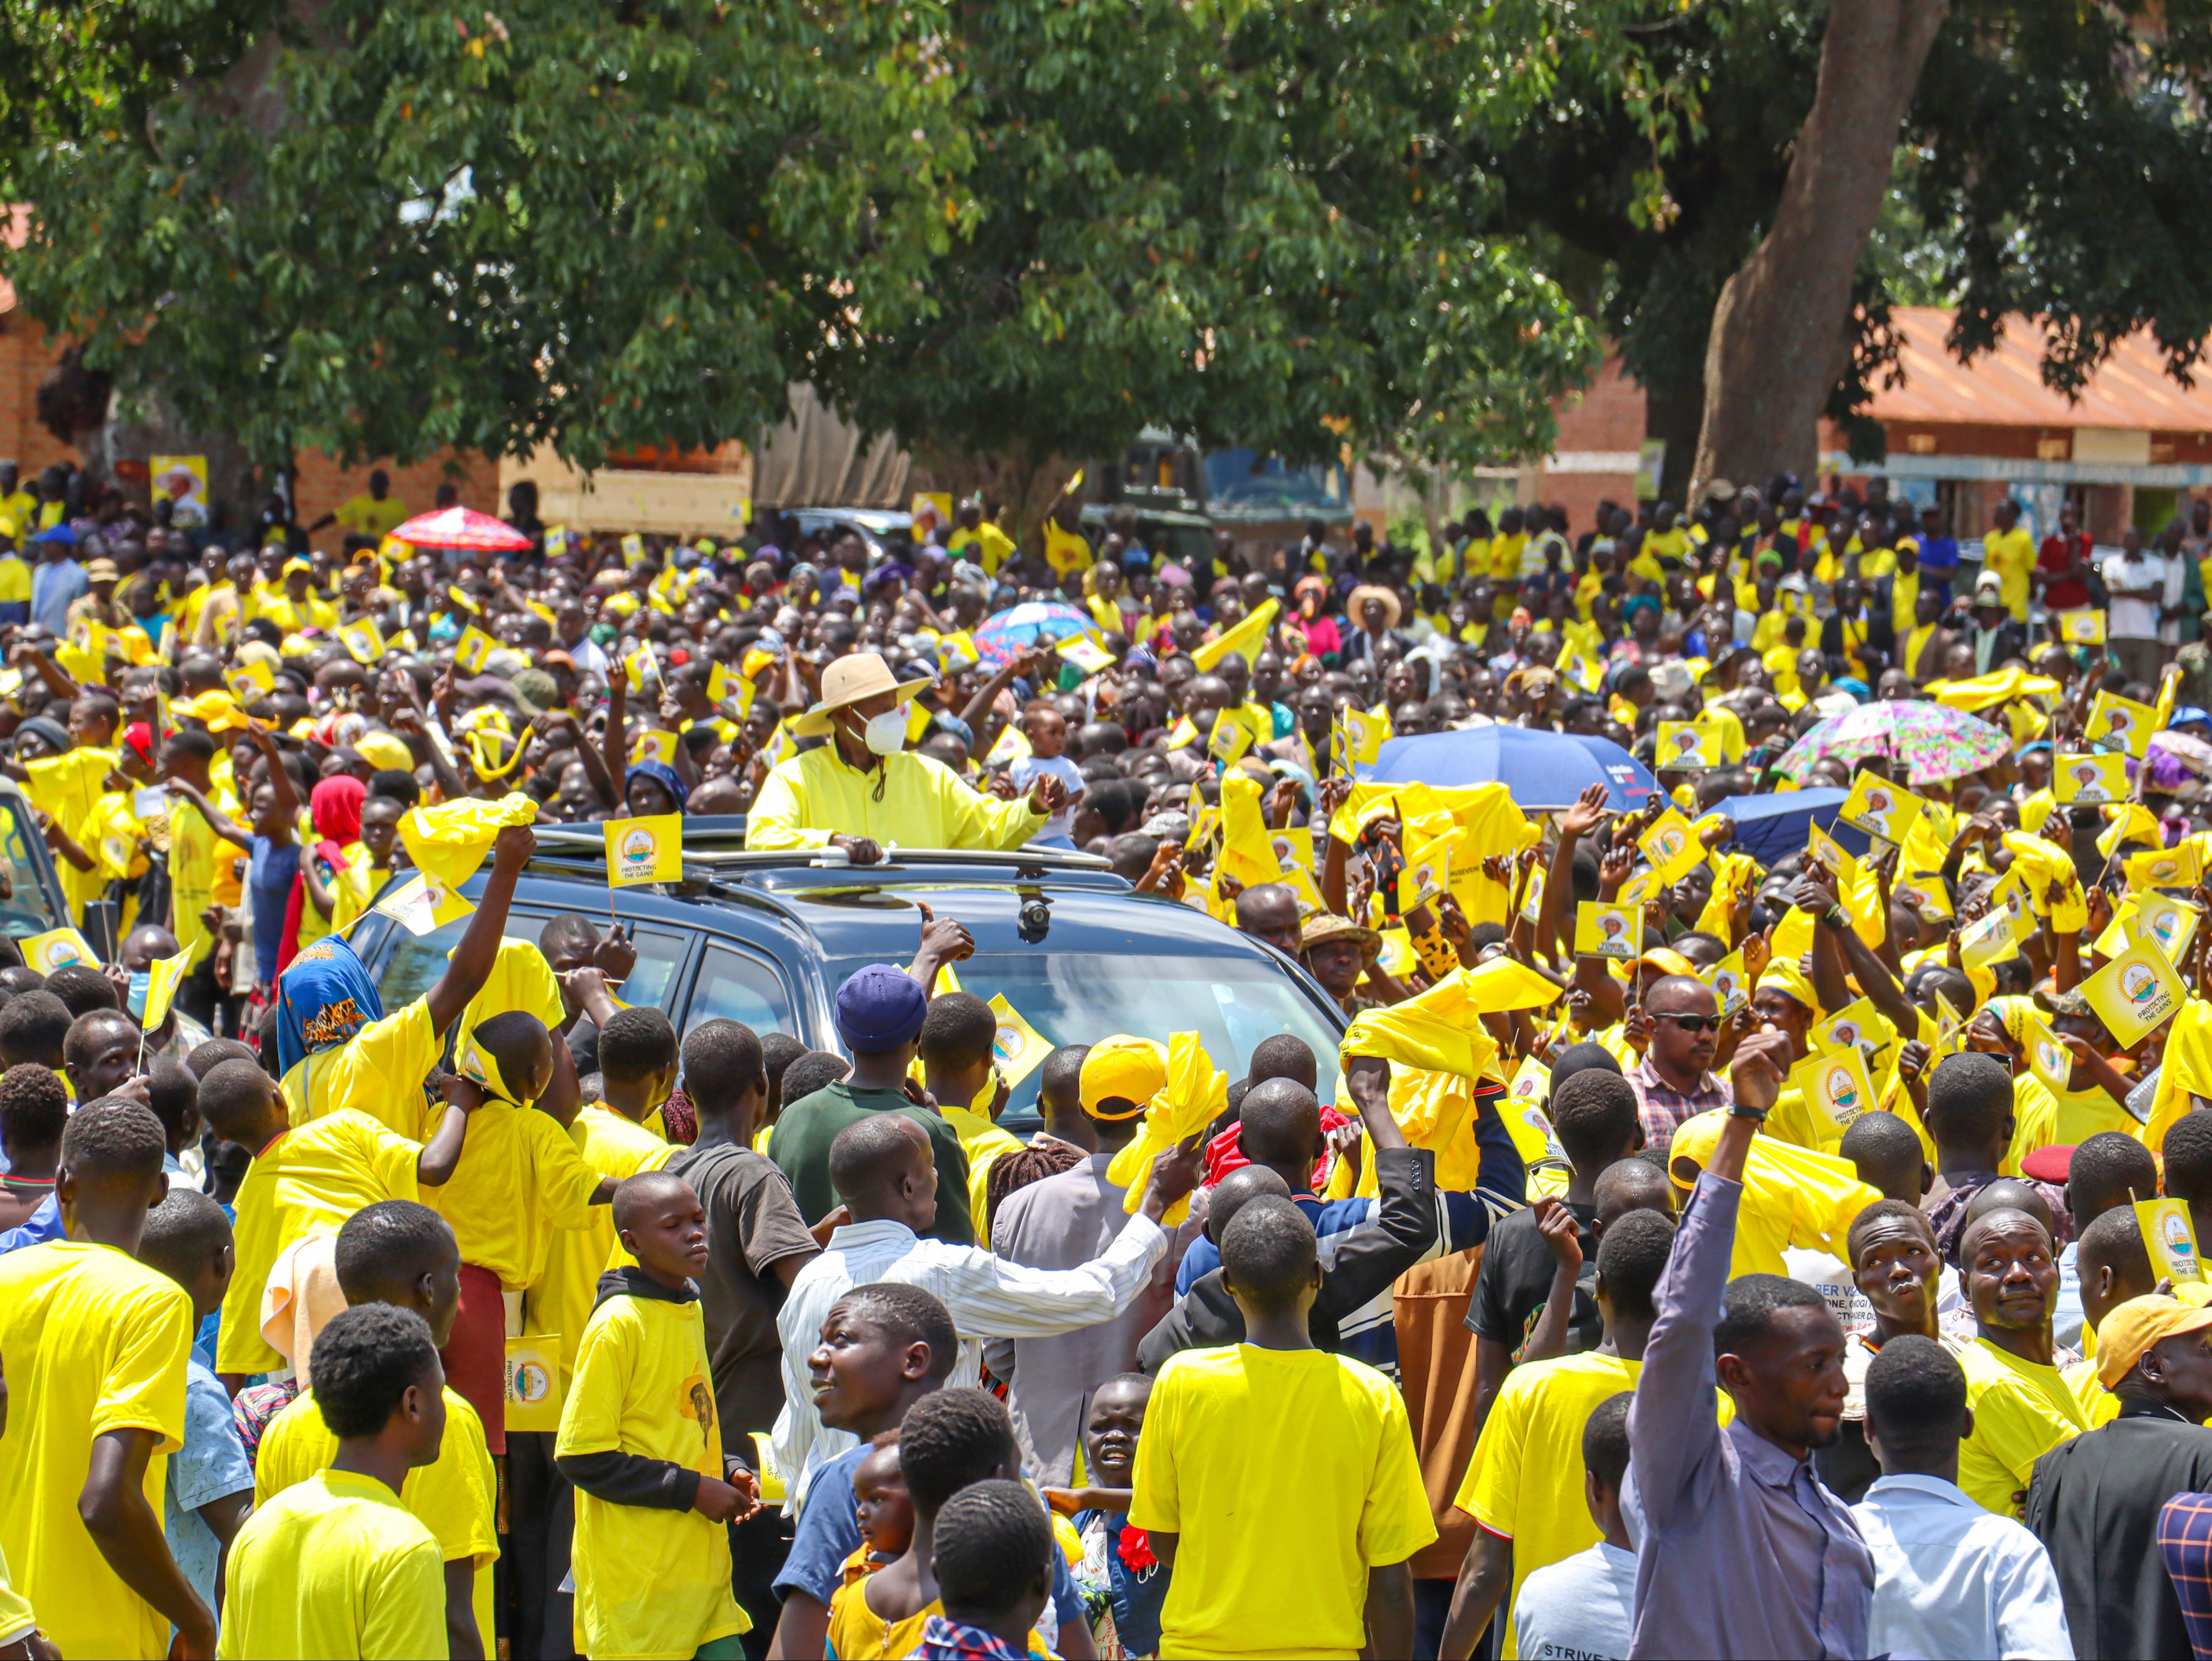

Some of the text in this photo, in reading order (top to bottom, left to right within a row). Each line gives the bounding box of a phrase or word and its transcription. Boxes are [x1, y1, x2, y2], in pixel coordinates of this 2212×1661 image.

[622, 864, 657, 873] PROTECTING
[2137, 990, 2170, 1019] PROTECTING
[2144, 999, 2172, 1022] THE GAINS
[1545, 1644, 1603, 1660] STRIVE
